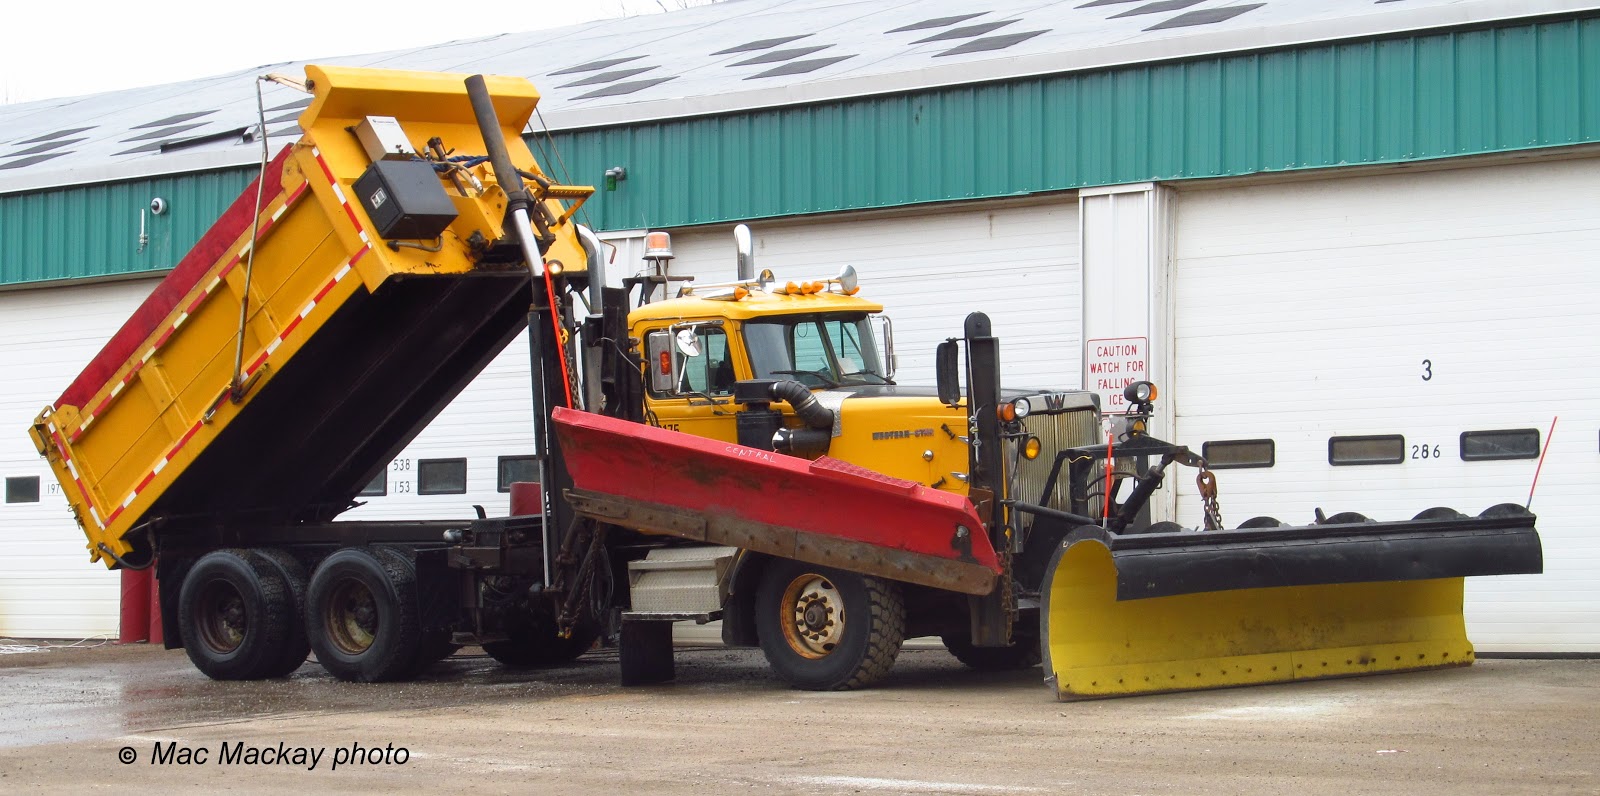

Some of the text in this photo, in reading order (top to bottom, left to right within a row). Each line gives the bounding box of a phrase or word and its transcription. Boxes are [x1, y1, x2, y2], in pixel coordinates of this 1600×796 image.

[1097, 345, 1137, 357] CAUTION
[1090, 360, 1144, 374] WATCH FOR
[1421, 359, 1432, 381] 3
[1109, 394, 1124, 405] ICE
[725, 446, 777, 463] CENTRAL
[1412, 444, 1440, 459] 286
[393, 459, 411, 471] 538
[394, 481, 410, 493] 153
